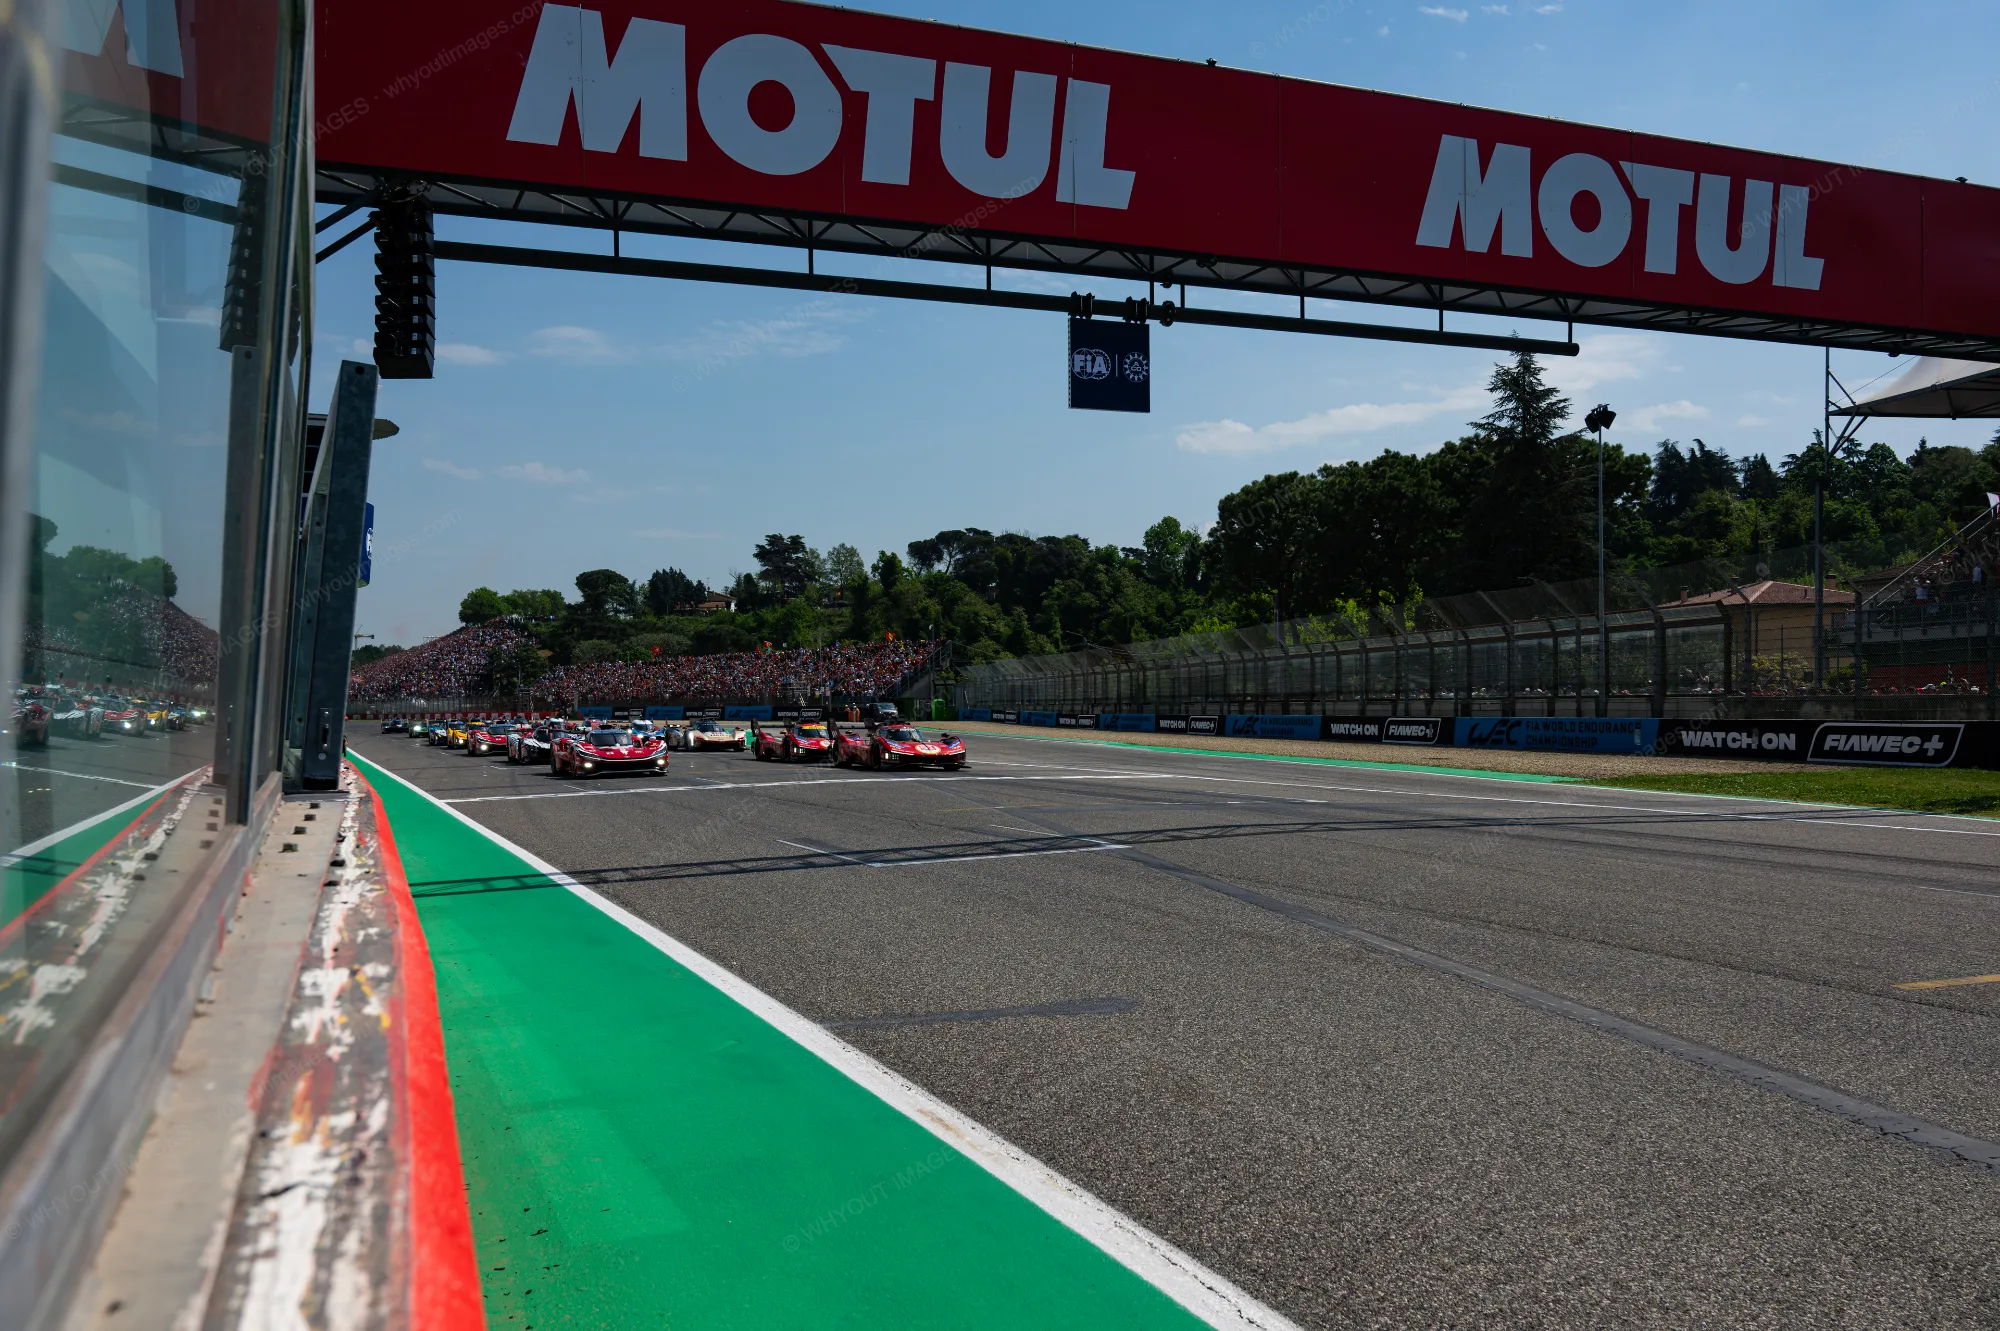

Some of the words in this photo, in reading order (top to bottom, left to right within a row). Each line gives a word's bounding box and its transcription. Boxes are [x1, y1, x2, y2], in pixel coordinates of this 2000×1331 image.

[506, 3, 1136, 210] MOTUL
[1415, 134, 1825, 291] MOTUL
[1331, 723, 1364, 735] WATCH
[1364, 724, 1379, 735] ON
[1467, 718, 1522, 746] WEC
[1526, 721, 1540, 732] FIA
[1543, 721, 1576, 733] WORLD
[1526, 735, 1598, 748] CHAMPIONSHIP
[1681, 730, 1757, 750] WATCH
[1762, 733, 1796, 751] ON
[1824, 733, 1945, 757] FIAWEC+
